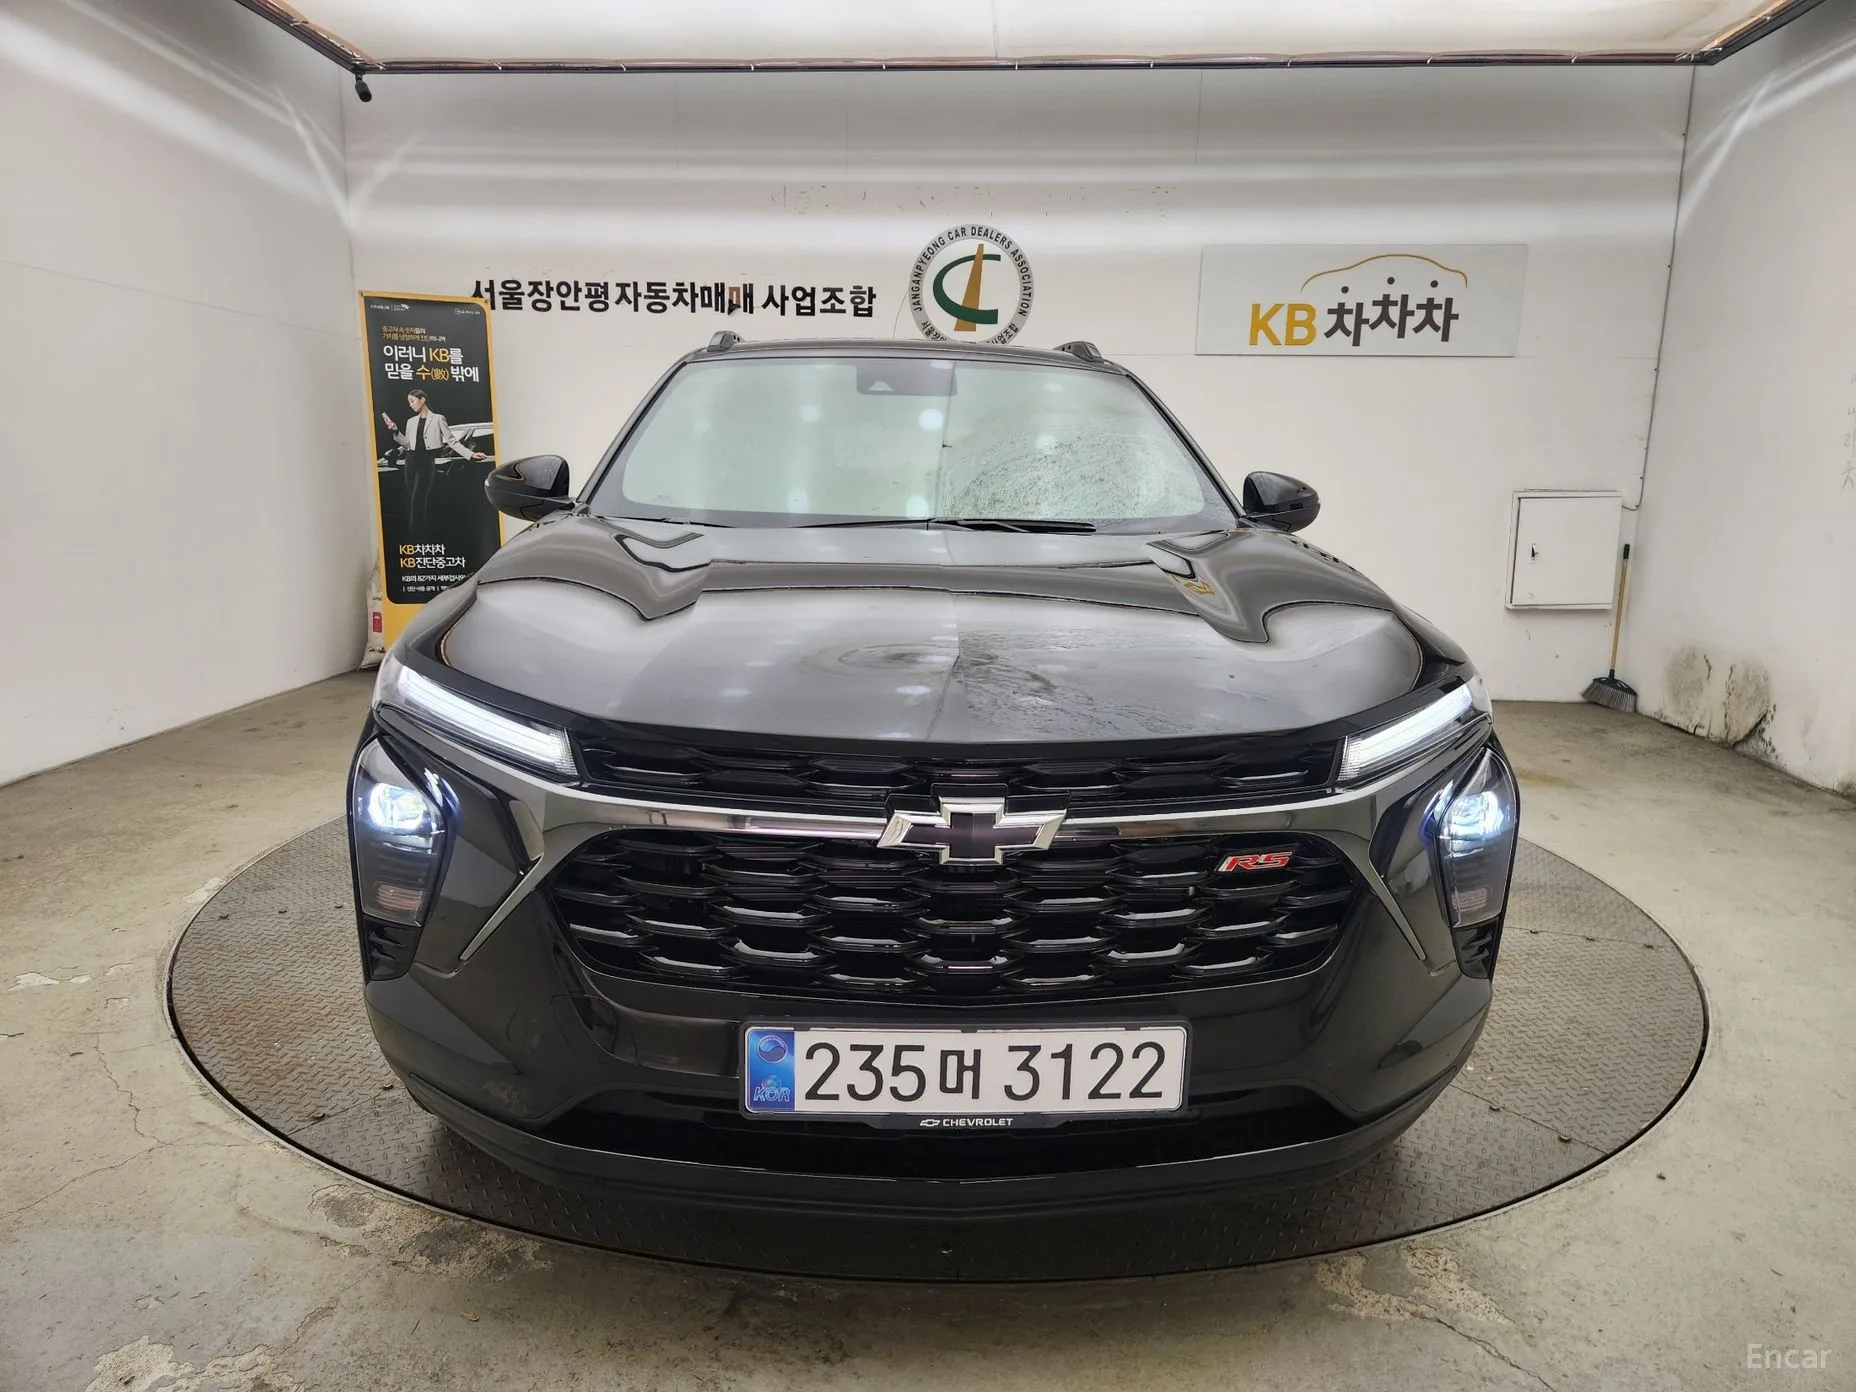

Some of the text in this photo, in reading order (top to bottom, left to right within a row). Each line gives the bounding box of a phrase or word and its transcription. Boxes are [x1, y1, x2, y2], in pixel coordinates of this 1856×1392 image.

[911, 226, 1032, 317] JANGANPYEONG CAR DEALERS ASSOCIATION
[471, 279, 877, 318] 서울장안평 자동차매매 사업조합
[1248, 292, 1460, 346] KB 차차차
[383, 345, 464, 365] 이러니 KB를
[384, 363, 414, 380] 믿을
[450, 366, 480, 382] 밖에
[399, 543, 446, 555] KB차차차
[400, 556, 466, 569] KB진단중고차
[1217, 851, 1293, 872] RS
[804, 1041, 1167, 1102] 235머 3122
[753, 1086, 791, 1102] KOR
[942, 1118, 1014, 1127] CHEVROLET
